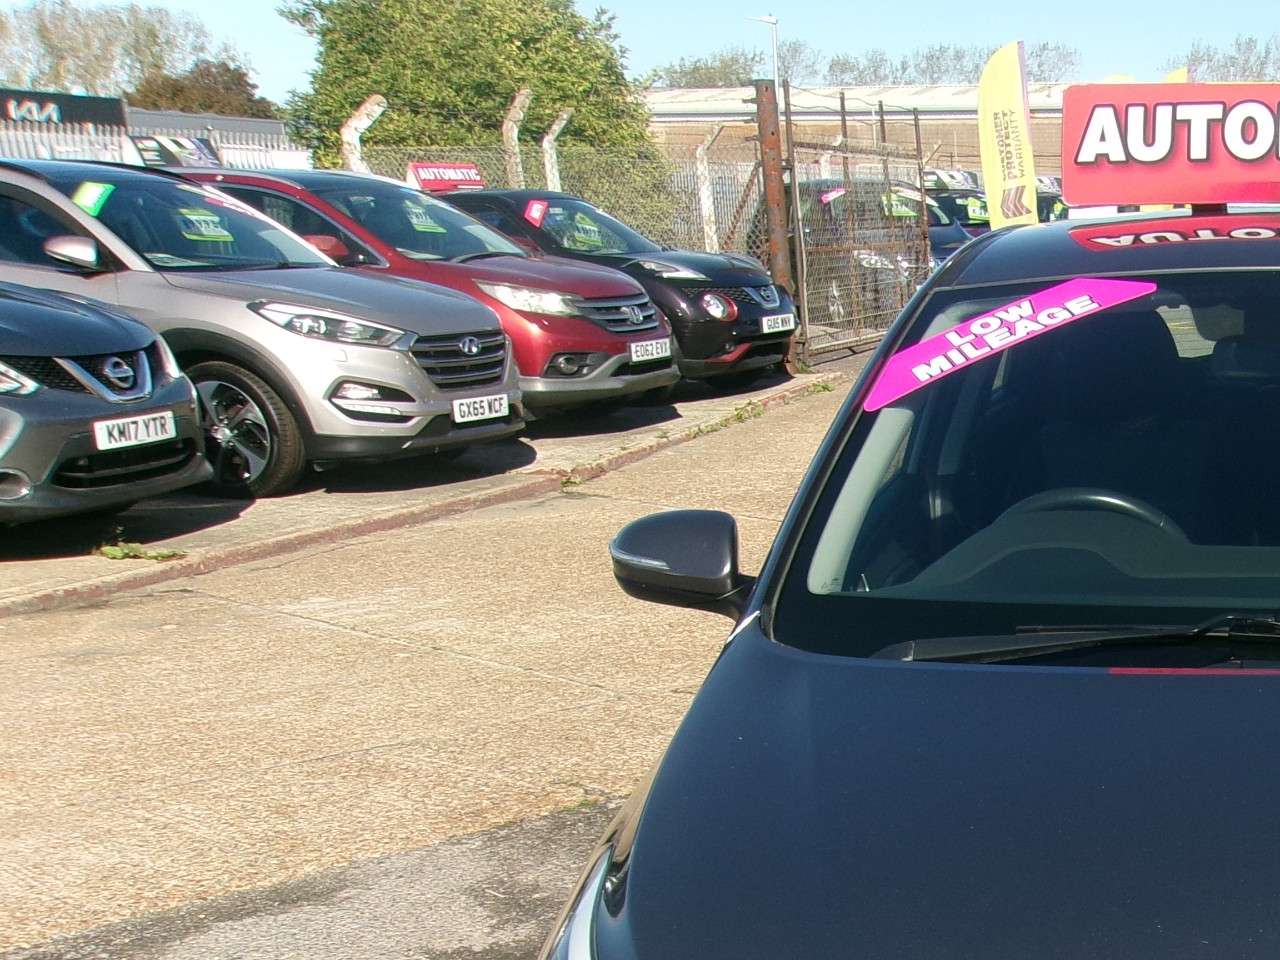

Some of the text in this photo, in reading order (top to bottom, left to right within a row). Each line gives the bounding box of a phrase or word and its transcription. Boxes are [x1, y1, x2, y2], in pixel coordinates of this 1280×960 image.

[1001, 110, 1018, 180] PROTECT
[1009, 109, 1025, 178] WARRANTY
[416, 167, 481, 181] AUTOMATIC
[911, 294, 1101, 383] MILEAGE
[944, 299, 1036, 347] LOW
[105, 415, 169, 444] KM17 YTR
[458, 397, 504, 418] GX65 WCF
